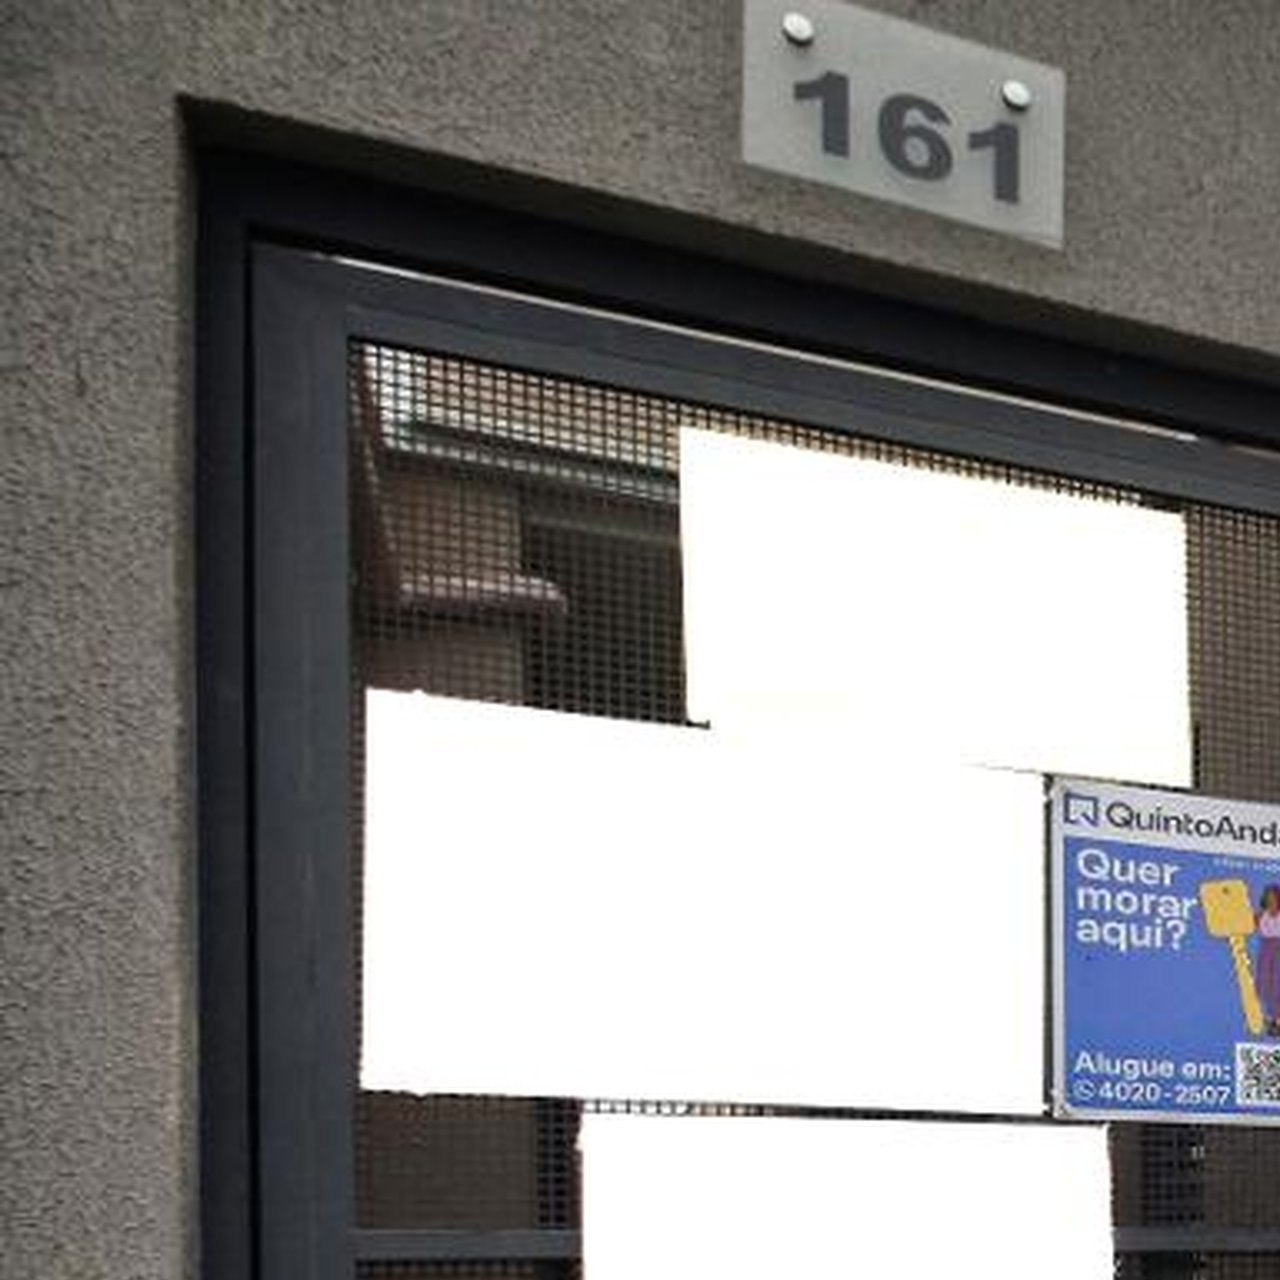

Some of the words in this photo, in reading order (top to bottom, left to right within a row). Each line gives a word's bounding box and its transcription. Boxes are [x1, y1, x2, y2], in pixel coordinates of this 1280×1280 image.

[794, 71, 1020, 204] 161
[1076, 848, 1180, 886] Quer
[1076, 889, 1198, 920] morar
[1076, 919, 1187, 951] aqui?
[1074, 1051, 1174, 1080] Alugue
[1182, 1061, 1232, 1081] em:
